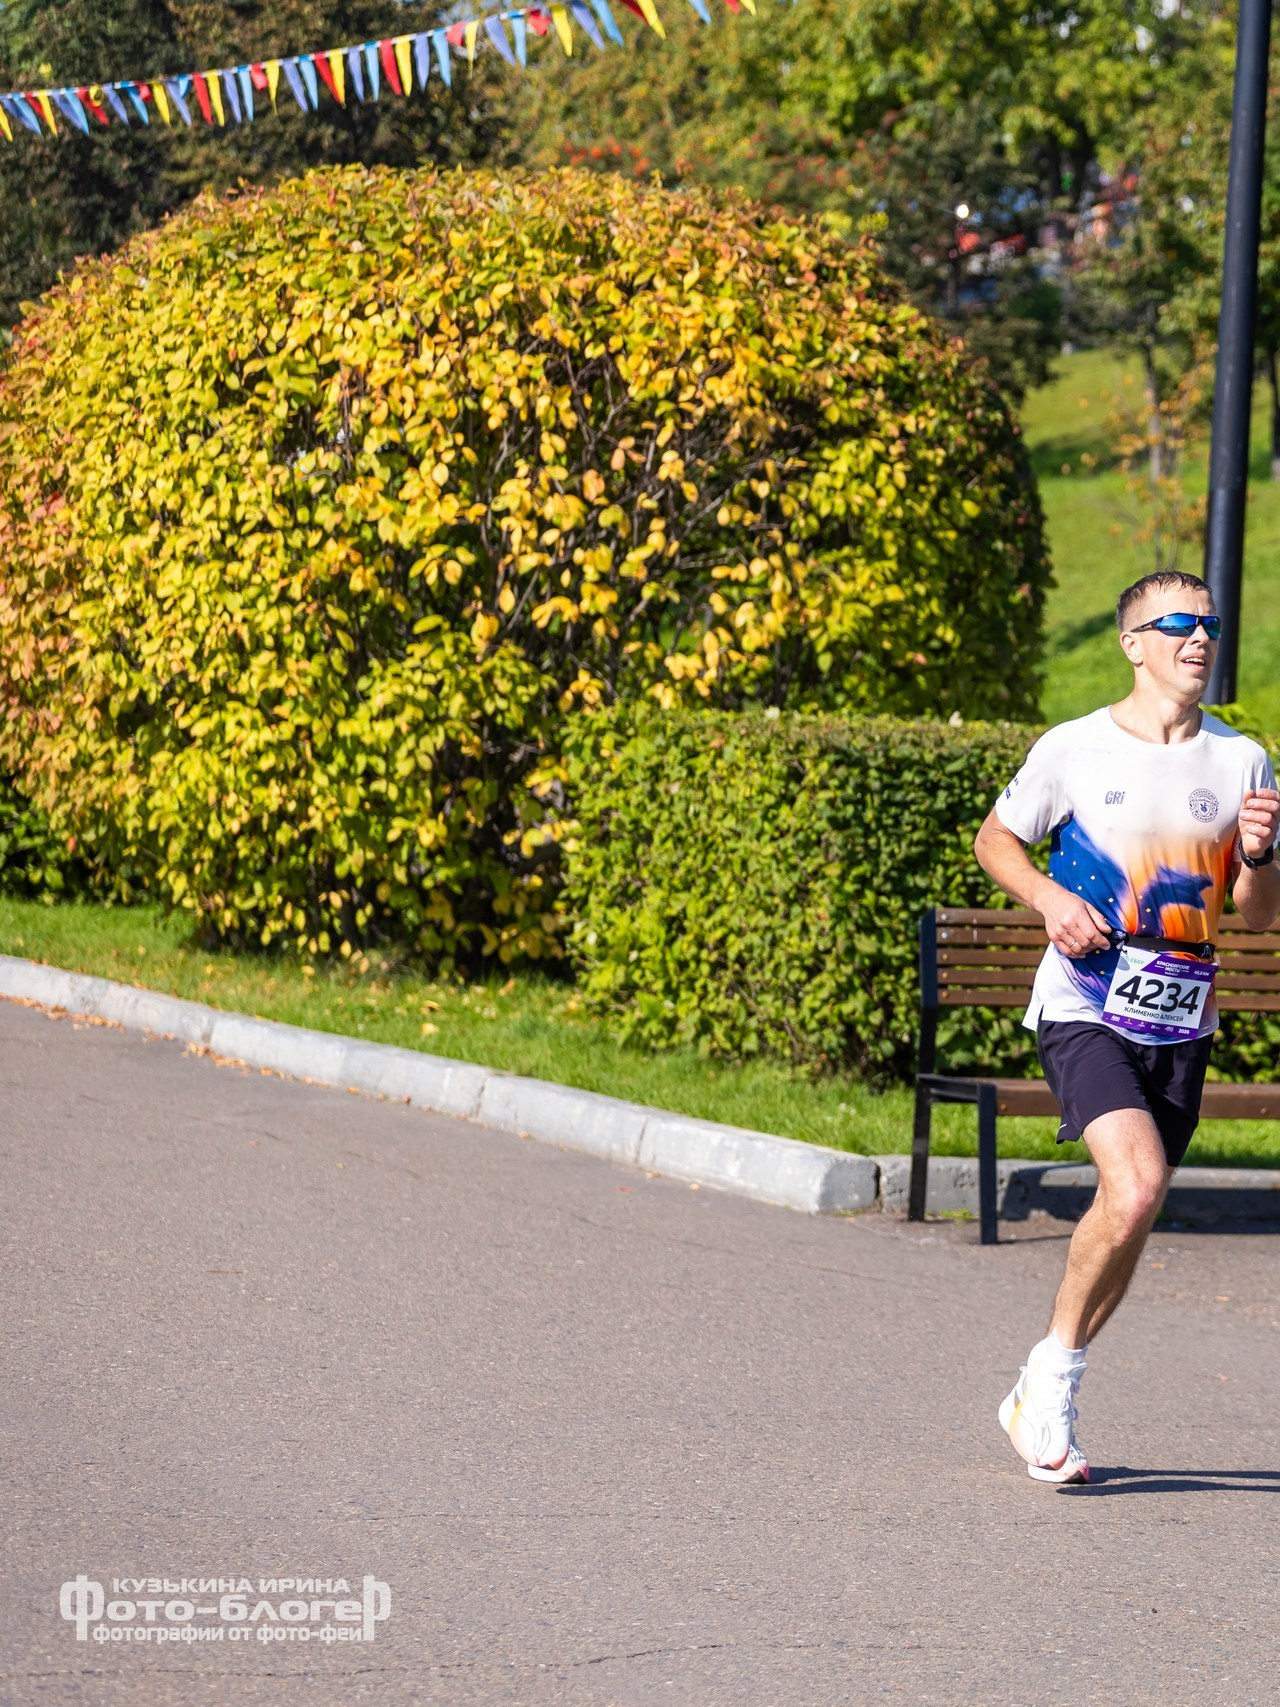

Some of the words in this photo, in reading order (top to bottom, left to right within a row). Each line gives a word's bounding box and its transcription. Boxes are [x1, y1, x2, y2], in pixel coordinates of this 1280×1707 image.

[1115, 975, 1201, 1015] 4234
[1124, 1006, 1160, 1019] КЛИМЕНКО
[1159, 1013, 1184, 1022] АЛЕКСЕЙ
